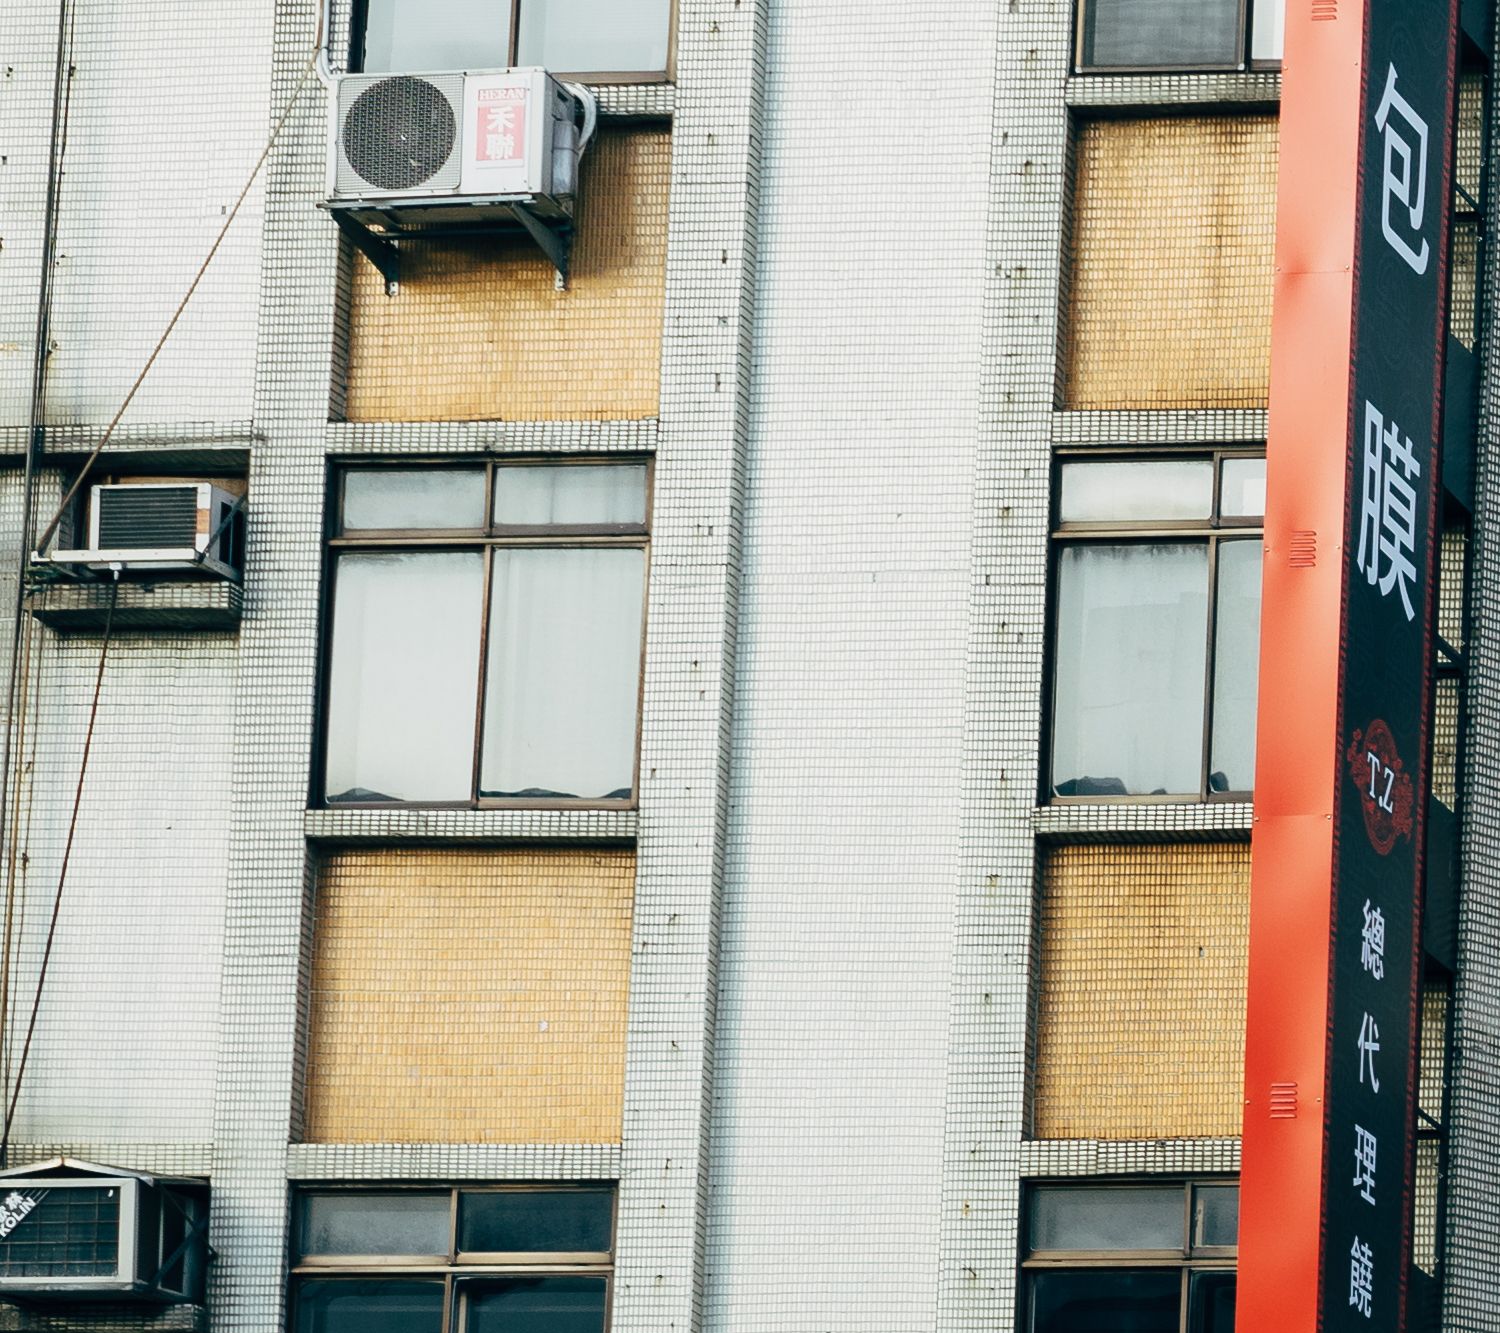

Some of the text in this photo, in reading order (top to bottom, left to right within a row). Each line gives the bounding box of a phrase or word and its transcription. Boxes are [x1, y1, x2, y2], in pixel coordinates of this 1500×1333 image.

[478, 87, 525, 100] HERAN
[486, 105, 514, 159] 禾聯
[1356, 62, 1430, 621] 包膜
